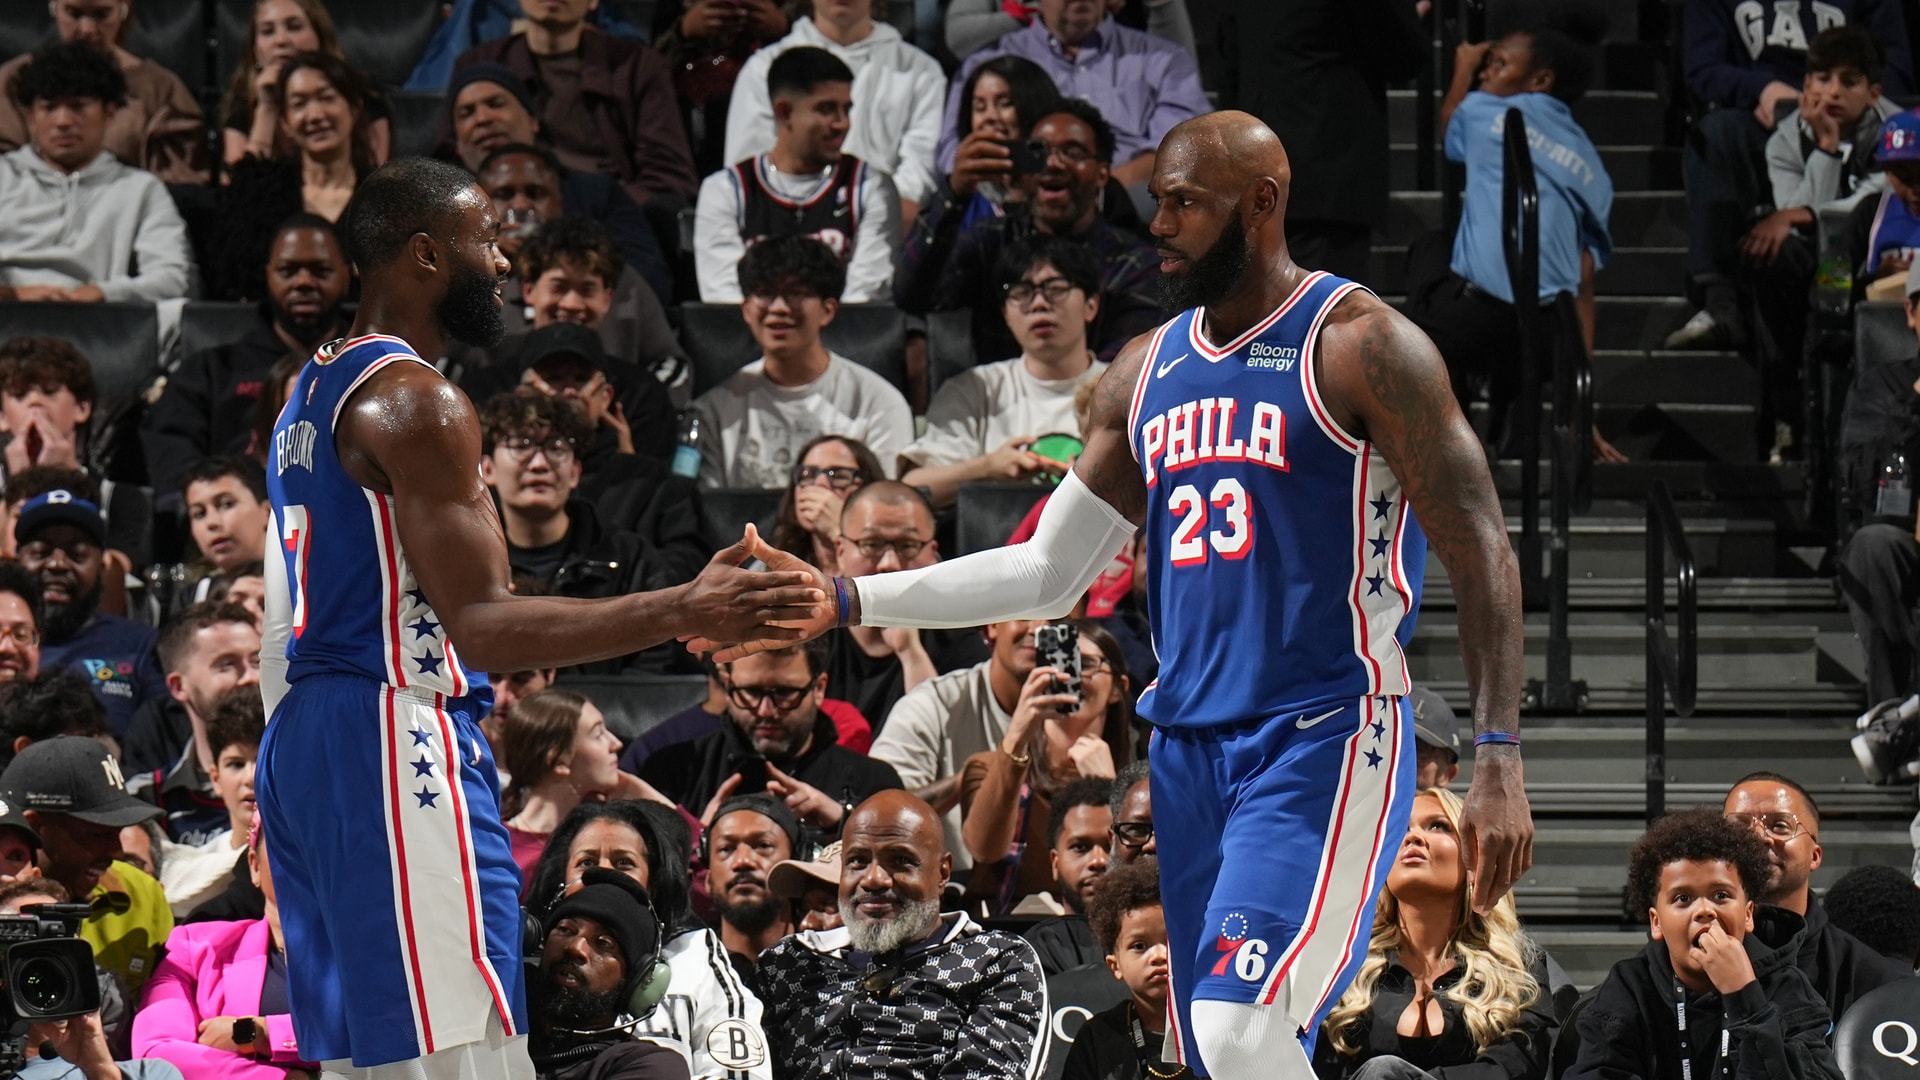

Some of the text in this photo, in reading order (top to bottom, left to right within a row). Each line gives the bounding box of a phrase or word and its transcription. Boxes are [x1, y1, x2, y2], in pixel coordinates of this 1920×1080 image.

[1247, 356, 1296, 372] energy
[1249, 342, 1298, 359] Bloom
[276, 420, 318, 477] BROWN
[1142, 397, 1291, 490] PHILA
[1168, 478, 1255, 569] 23
[283, 504, 312, 640] 7
[1211, 934, 1269, 982] 76
[728, 1026, 749, 1060] B
[1872, 1020, 1919, 1066] Q
